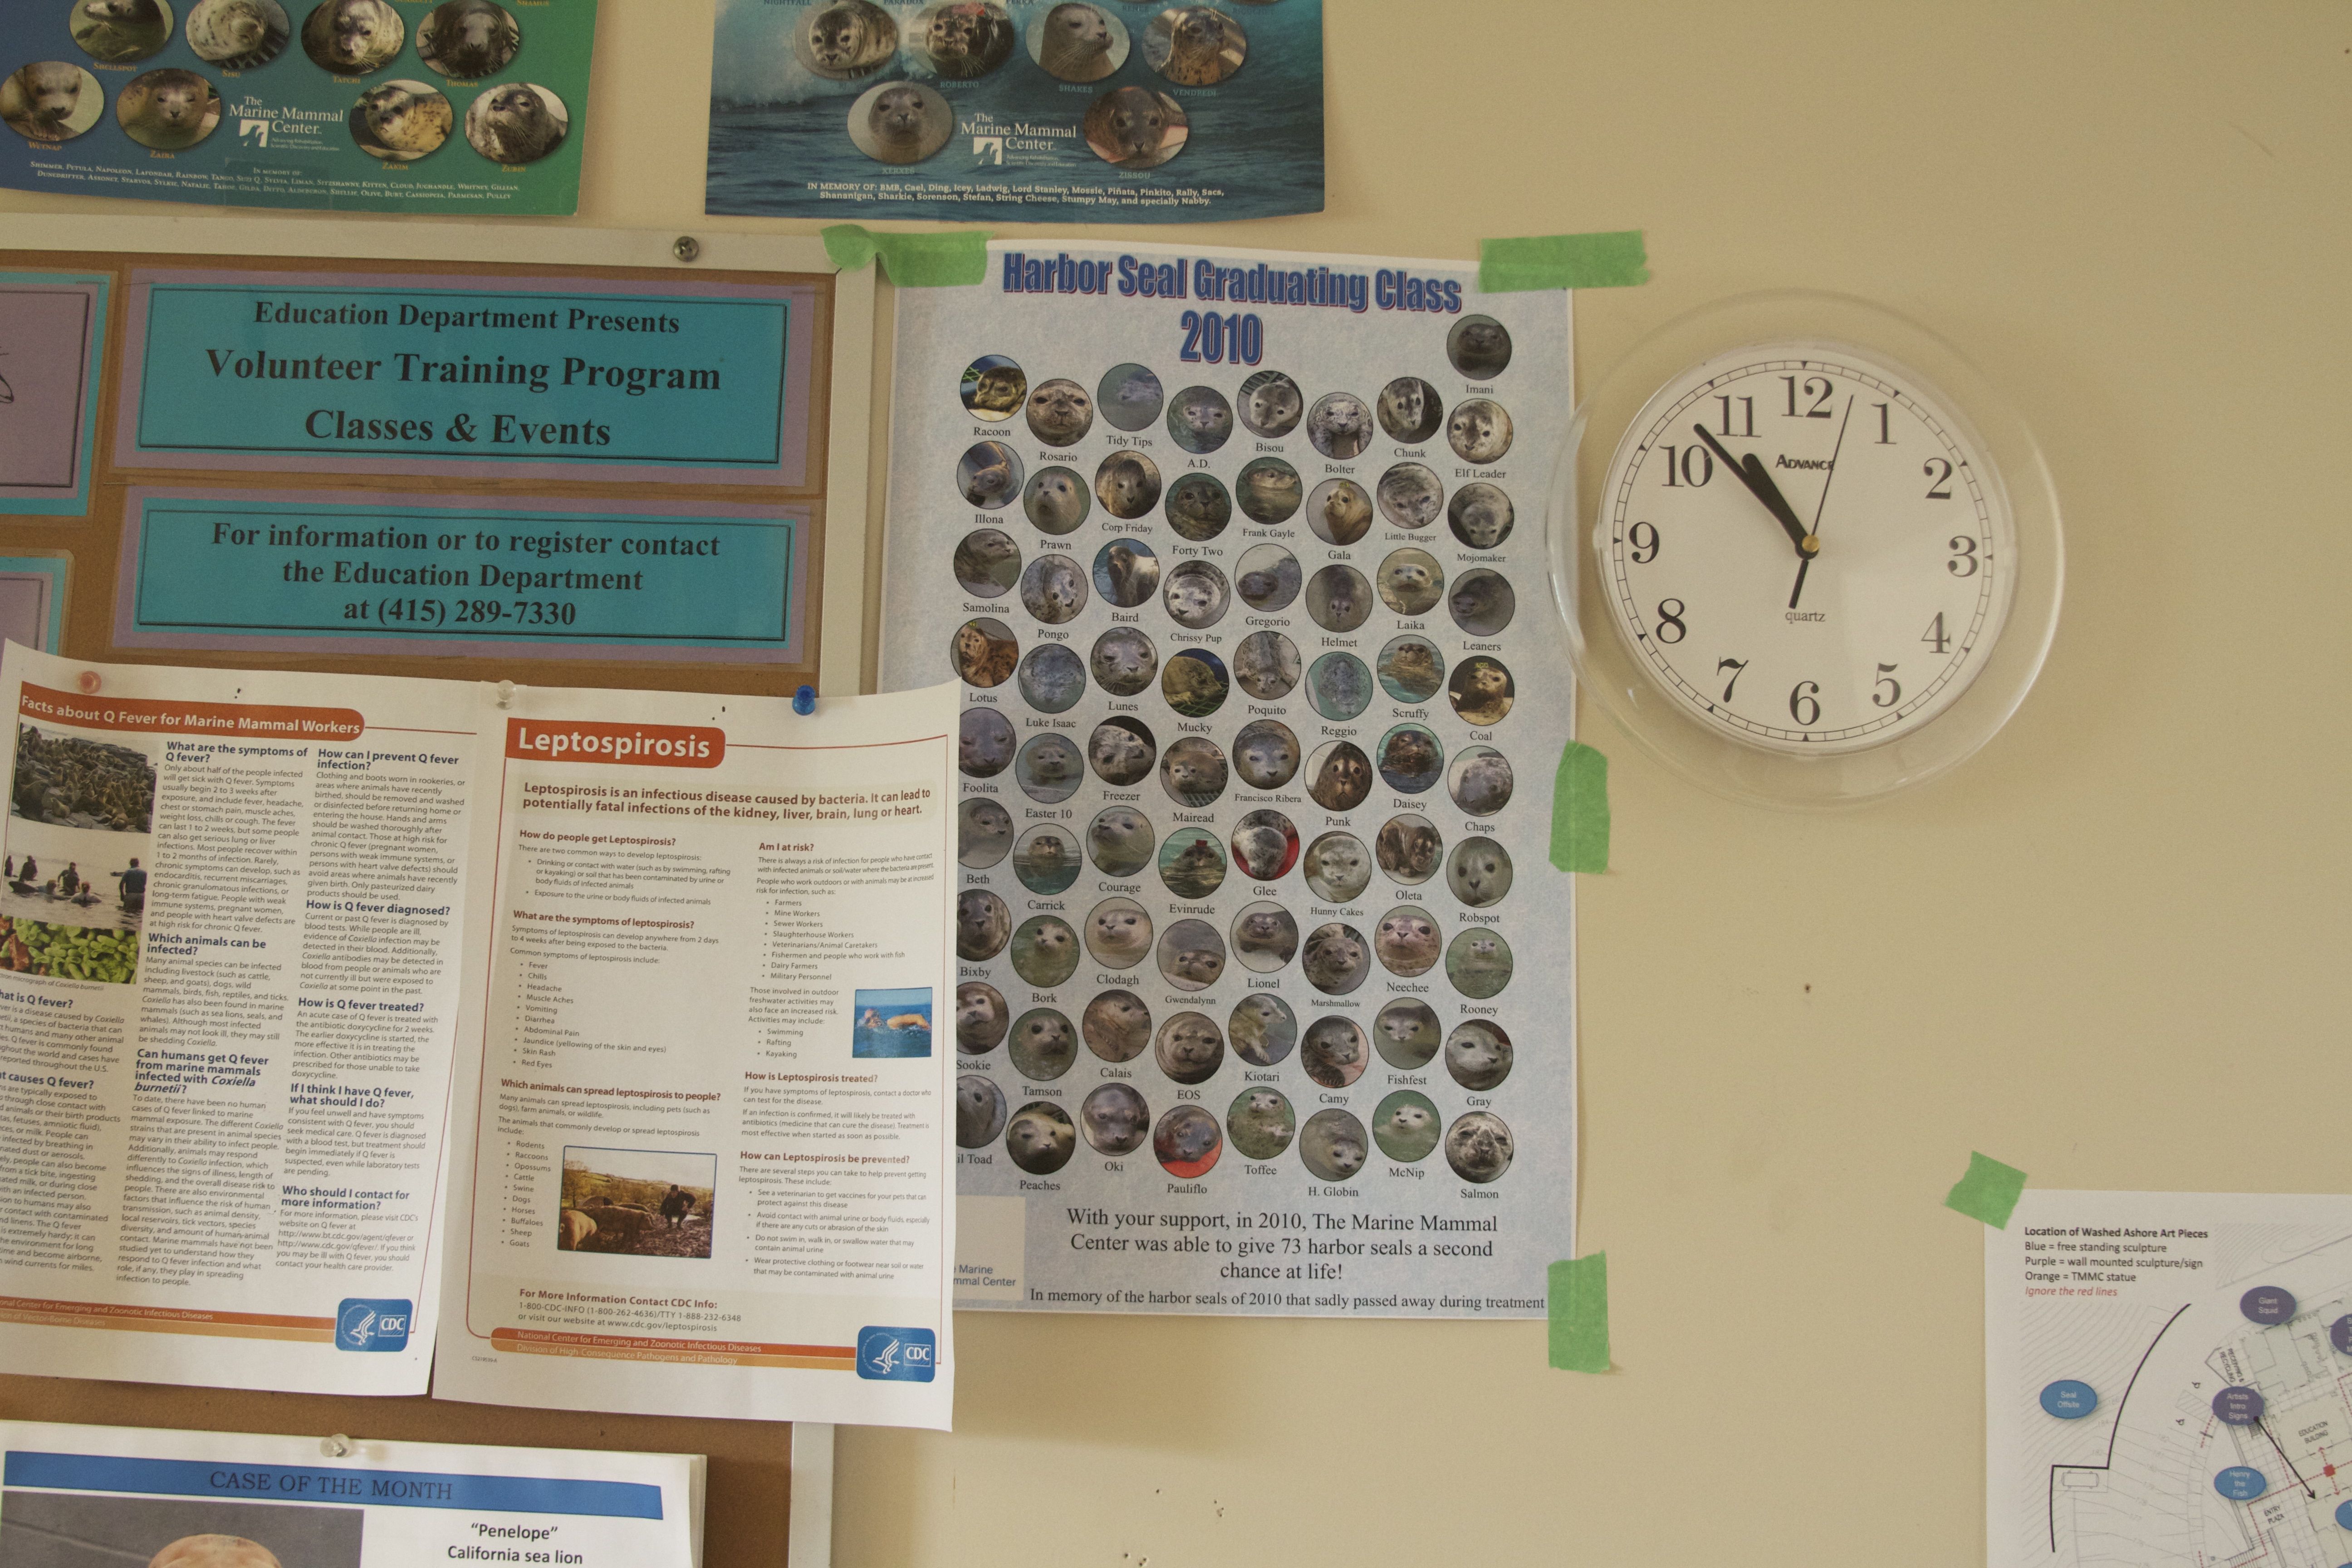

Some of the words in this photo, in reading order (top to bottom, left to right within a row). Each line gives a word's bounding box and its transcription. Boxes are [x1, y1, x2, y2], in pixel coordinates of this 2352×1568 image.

[244, 96, 262, 105] The
[229, 104, 278, 118] Marine
[282, 107, 343, 122] Mammal
[975, 113, 993, 122] The
[961, 122, 1010, 135] Marine
[1015, 123, 1076, 138] Mammal
[880, 184, 902, 192] BMB,
[928, 184, 951, 193] Ding,
[954, 184, 973, 193] Icey,
[976, 184, 1010, 194] Ladwig,
[1034, 186, 1069, 195] Stanley,
[1003, 253, 1111, 296] Harbor
[1117, 257, 1187, 299] Seal
[1193, 259, 1368, 311] Graduating
[1375, 270, 1461, 313] Class
[253, 301, 389, 326] Education
[399, 303, 558, 333] Department
[568, 309, 680, 335] Presents
[1181, 310, 1262, 364] 2010
[206, 348, 382, 382] Volunteer
[394, 353, 549, 393] Training
[562, 356, 720, 394] Program
[1466, 384, 1493, 394] Imani
[1779, 375, 1833, 418] 12
[1714, 395, 1761, 438] 11
[306, 410, 433, 443] Classes
[446, 413, 477, 443] &
[492, 414, 611, 447] Events
[1871, 403, 1896, 445] 1
[973, 426, 1010, 436] Racoon
[1255, 442, 1284, 452] Bisou
[1394, 448, 1426, 457] Chunk
[1039, 451, 1077, 462] Rosario
[1325, 464, 1355, 474] Bolter
[1658, 444, 1713, 487] 10
[1923, 457, 1952, 500] 2
[975, 514, 1004, 524] Illona
[212, 521, 262, 546] For
[268, 522, 427, 549] information
[438, 534, 466, 550] or
[475, 530, 500, 551] to
[509, 531, 612, 559] register
[621, 531, 720, 557] contact
[1629, 521, 1660, 564] 9
[1172, 545, 1199, 557] Forty
[1201, 546, 1223, 556] Two
[1947, 535, 1978, 577] 3
[282, 560, 327, 584] the
[333, 561, 469, 586] Education
[479, 566, 642, 593] Department
[344, 600, 369, 620] at
[377, 598, 446, 627] (415)
[455, 599, 576, 626] 289-7330
[962, 603, 1009, 613] Samolina
[1656, 598, 1687, 644] 8
[1785, 612, 1825, 623] quartz
[1397, 620, 1425, 630] Laika
[1038, 629, 1069, 641] Pongo
[1921, 611, 1951, 654] 4
[1717, 657, 1749, 703] 7
[1872, 663, 1901, 707] 5
[1108, 701, 1138, 711] Lunes
[1790, 681, 1820, 725] 6
[22, 696, 54, 715] Facts
[57, 704, 100, 721] about
[103, 711, 115, 725] Q
[119, 711, 157, 724] Fever
[161, 713, 181, 725] for
[184, 714, 235, 728] Marine
[239, 717, 299, 731] Mammal
[302, 720, 360, 734] Workers
[1321, 726, 1357, 738] Reggio
[518, 727, 710, 760] Leptospirosis
[524, 782, 608, 799] Leptospirosis
[610, 786, 620, 797] is
[623, 789, 638, 799] an
[642, 788, 703, 801] infectious
[706, 790, 752, 803] disease
[755, 794, 798, 805] caused
[801, 794, 816, 808] by
[819, 793, 868, 805] bacteria.
[871, 793, 878, 803] It
[881, 793, 898, 802] can
[901, 789, 918, 801] lead
[921, 789, 930, 798] to
[1235, 794, 1273, 802] Francisco
[1465, 821, 1495, 834] Chaps
[1098, 882, 1142, 895] Courage
[529, 961, 548, 970] Fever
[960, 966, 991, 979] Bixby
[527, 983, 562, 993] Headache
[1311, 999, 1360, 1007] Marshmallow
[1460, 1004, 1498, 1017] Rooney
[1100, 1068, 1132, 1078] Calais
[1387, 1074, 1426, 1085] Fishfest
[1177, 1090, 1200, 1100] EOS
[1389, 1167, 1425, 1180] McNip
[1019, 1180, 1061, 1191] Peaches
[1067, 1209, 1112, 1227] With
[1114, 1212, 1155, 1230] your
[1159, 1211, 1230, 1231] support,
[1236, 1211, 1253, 1228] in
[1258, 1212, 1306, 1232] 2010,
[1312, 1213, 1346, 1230] The
[1351, 1214, 1414, 1231] Marine
[1420, 1215, 1498, 1232] Mammal
[2025, 1227, 2067, 1237] Location
[2068, 1227, 2080, 1237] of
[2082, 1227, 2121, 1238] Washed
[2123, 1228, 2157, 1238] Ashore
[2160, 1229, 2176, 1238] Art
[2178, 1229, 2208, 1239] Pieces
[1071, 1234, 1131, 1253] Center
[1134, 1240, 1168, 1252] was
[1173, 1235, 1210, 1253] able
[1215, 1239, 1232, 1254] to
[1238, 1236, 1275, 1258] give
[1281, 1238, 1301, 1254] 73
[1307, 1238, 1366, 1255] harbor
[1370, 1239, 1412, 1256] seals
[1418, 1244, 1428, 1256] a
[1433, 1240, 1494, 1257] second
[1220, 1263, 1282, 1279] chance
[1286, 1265, 1302, 1279] at
[1308, 1263, 1342, 1280] life!
[519, 1289, 536, 1298] For
[538, 1290, 564, 1300] More
[566, 1292, 627, 1304] Information
[630, 1297, 668, 1306] Contact
[671, 1298, 691, 1308] CDC
[695, 1299, 717, 1308] Info:
[2025, 1287, 2057, 1298] Ignore
[2059, 1287, 2073, 1296] the
[2077, 1287, 2092, 1296] red
[2096, 1287, 2117, 1297] lines
[381, 1317, 403, 1331] CDC
[905, 1346, 930, 1361] CDC
[2229, 1412, 2248, 1420] Signs
[2230, 1471, 2250, 1480] Henry
[210, 1470, 271, 1491] CASE
[279, 1474, 313, 1493] OF
[318, 1475, 362, 1496] THE
[371, 1477, 453, 1501] MONTH
[447, 1545, 520, 1562] California
[524, 1552, 550, 1563] sea
[555, 1549, 583, 1564] lion
